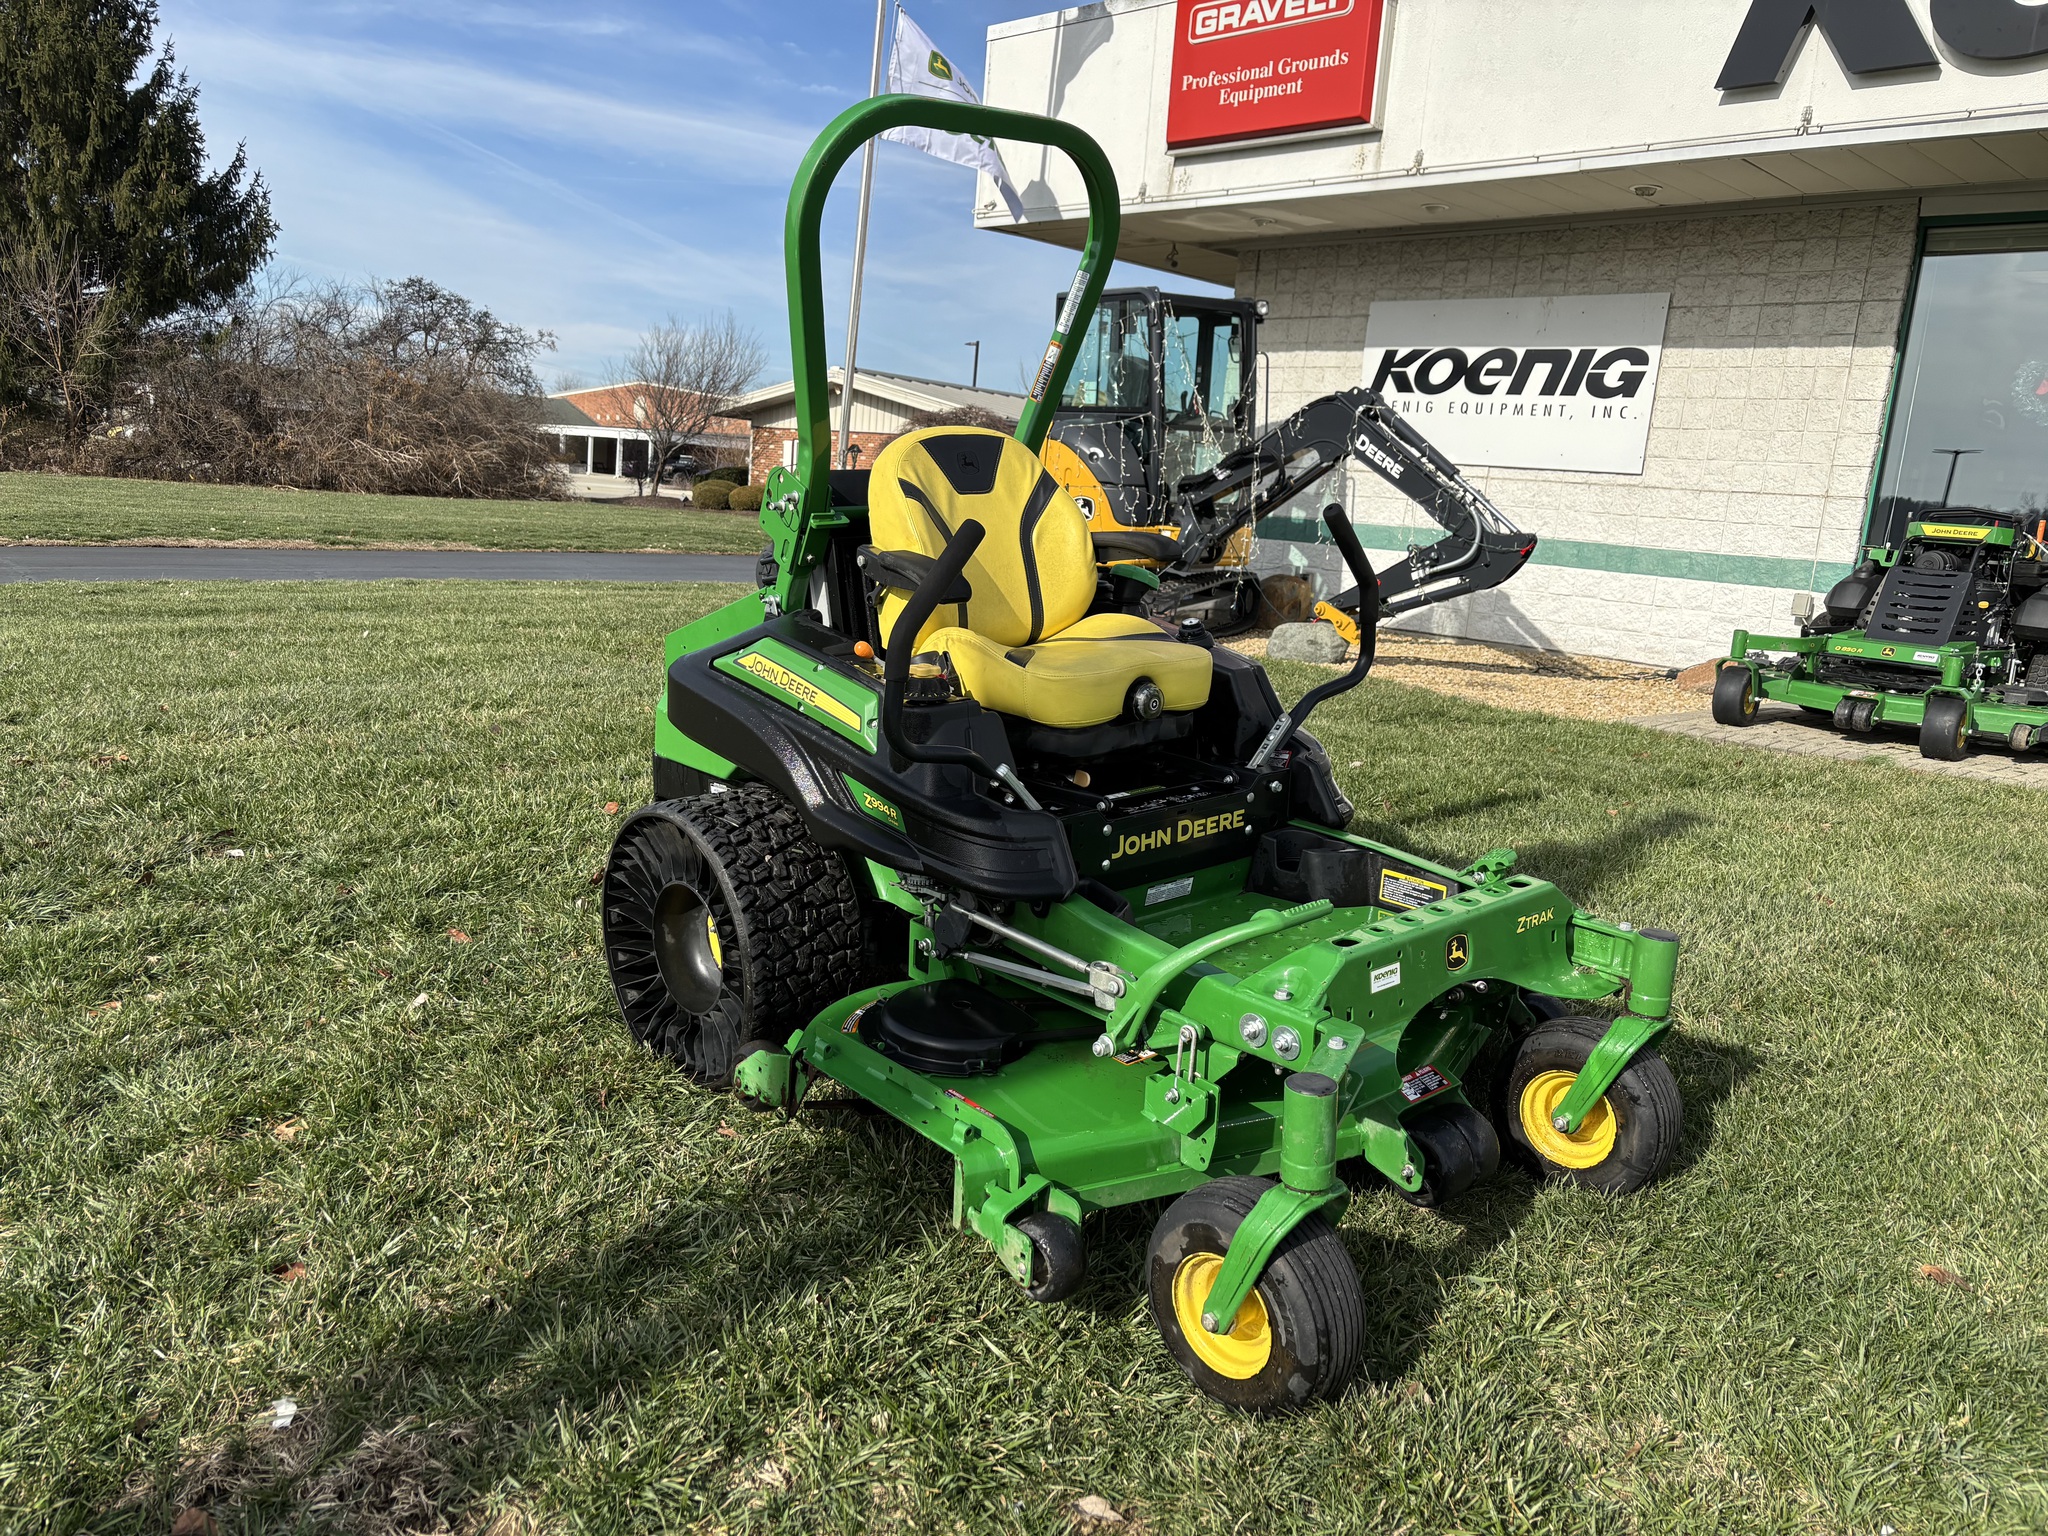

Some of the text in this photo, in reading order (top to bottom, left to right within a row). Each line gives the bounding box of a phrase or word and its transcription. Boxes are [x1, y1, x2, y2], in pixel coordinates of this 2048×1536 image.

[1181, 48, 1350, 91] Professional Grounds
[1218, 77, 1304, 107] Equipment
[1391, 400, 1638, 420] ENIG EQUIPMENT, INC.
[1355, 434, 1404, 479] DEERE
[1931, 527, 1979, 537] JOHN DEERE
[748, 656, 818, 704] JOHN DEERE
[1111, 808, 1245, 860] JOHN DEERE
[1516, 906, 1555, 934] ZTRAK
